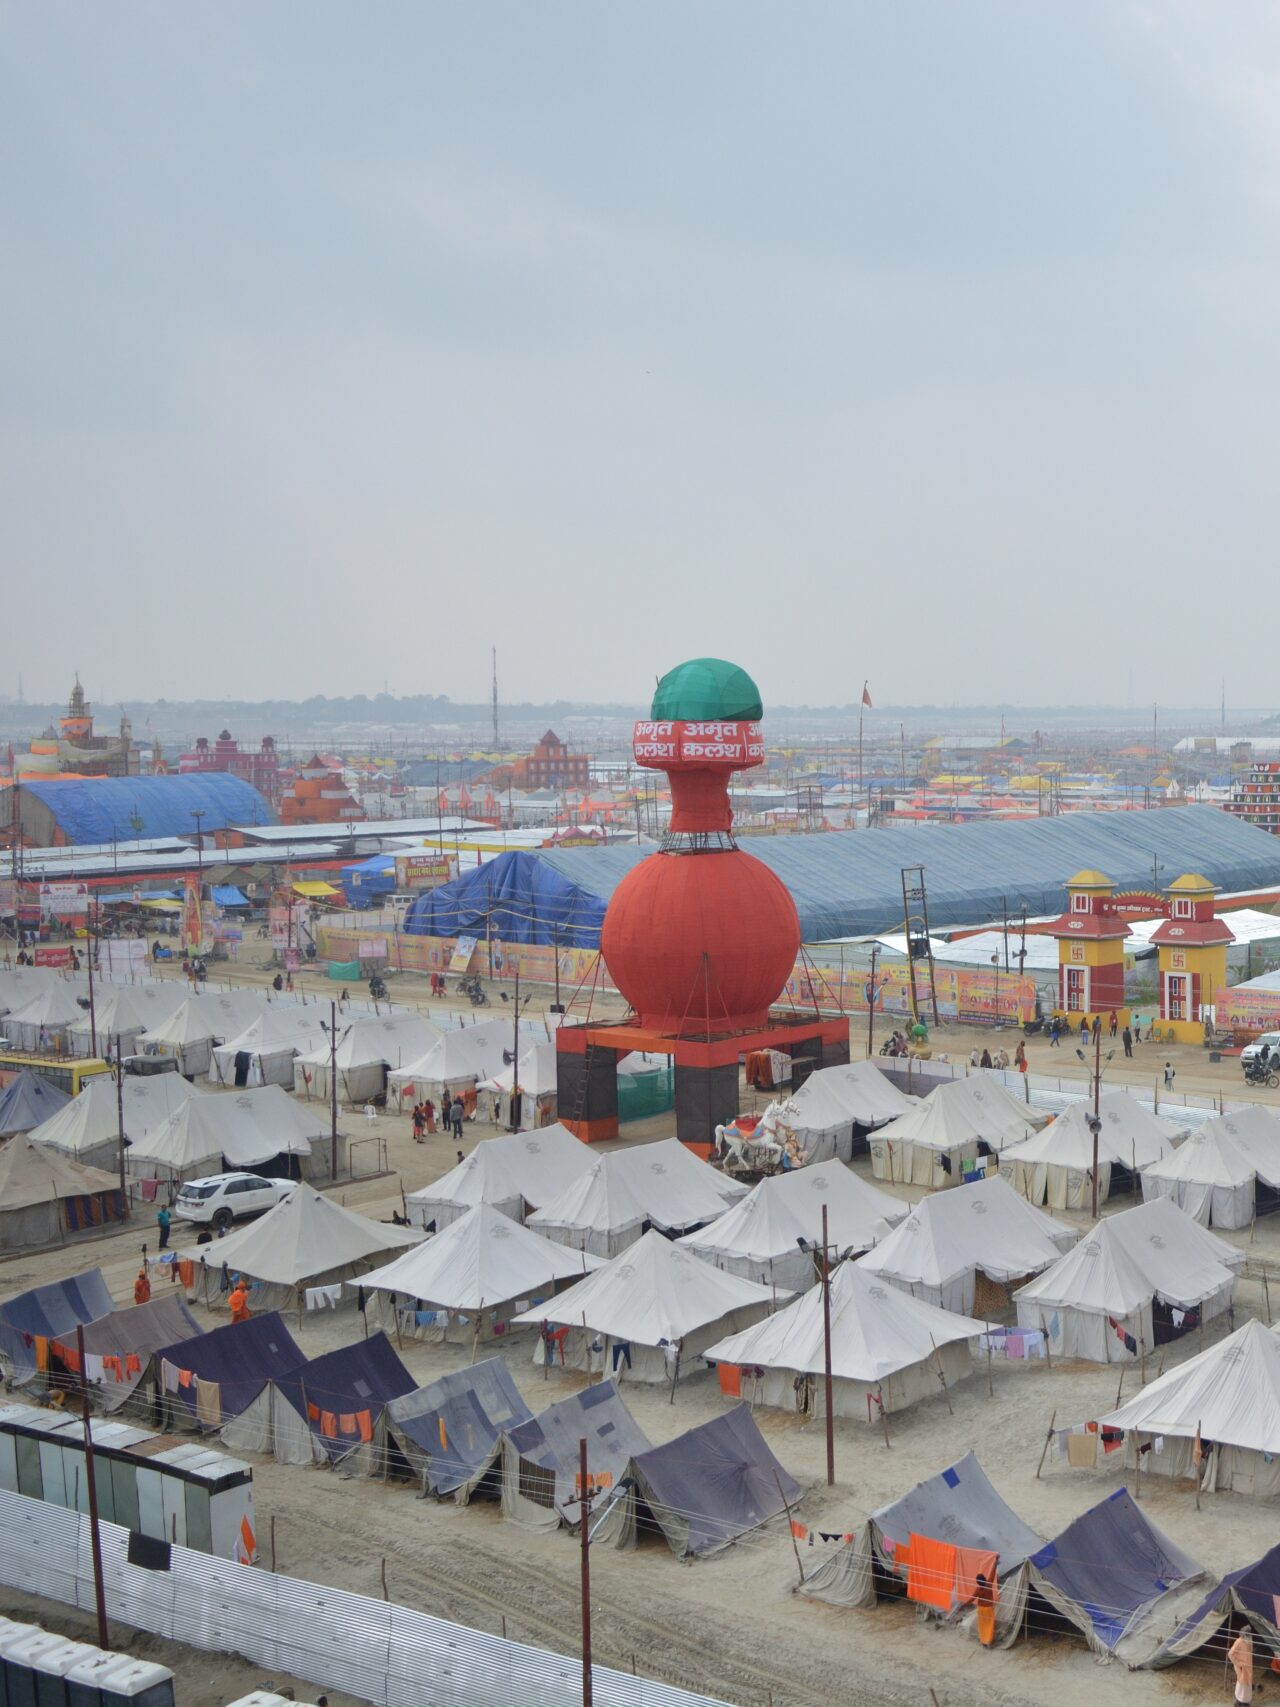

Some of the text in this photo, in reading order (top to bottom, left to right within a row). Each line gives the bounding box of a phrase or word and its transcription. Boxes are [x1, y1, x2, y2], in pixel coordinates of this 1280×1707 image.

[636, 722, 674, 741] अमृत
[683, 722, 738, 742] अमृत
[682, 743, 742, 758] कलश
